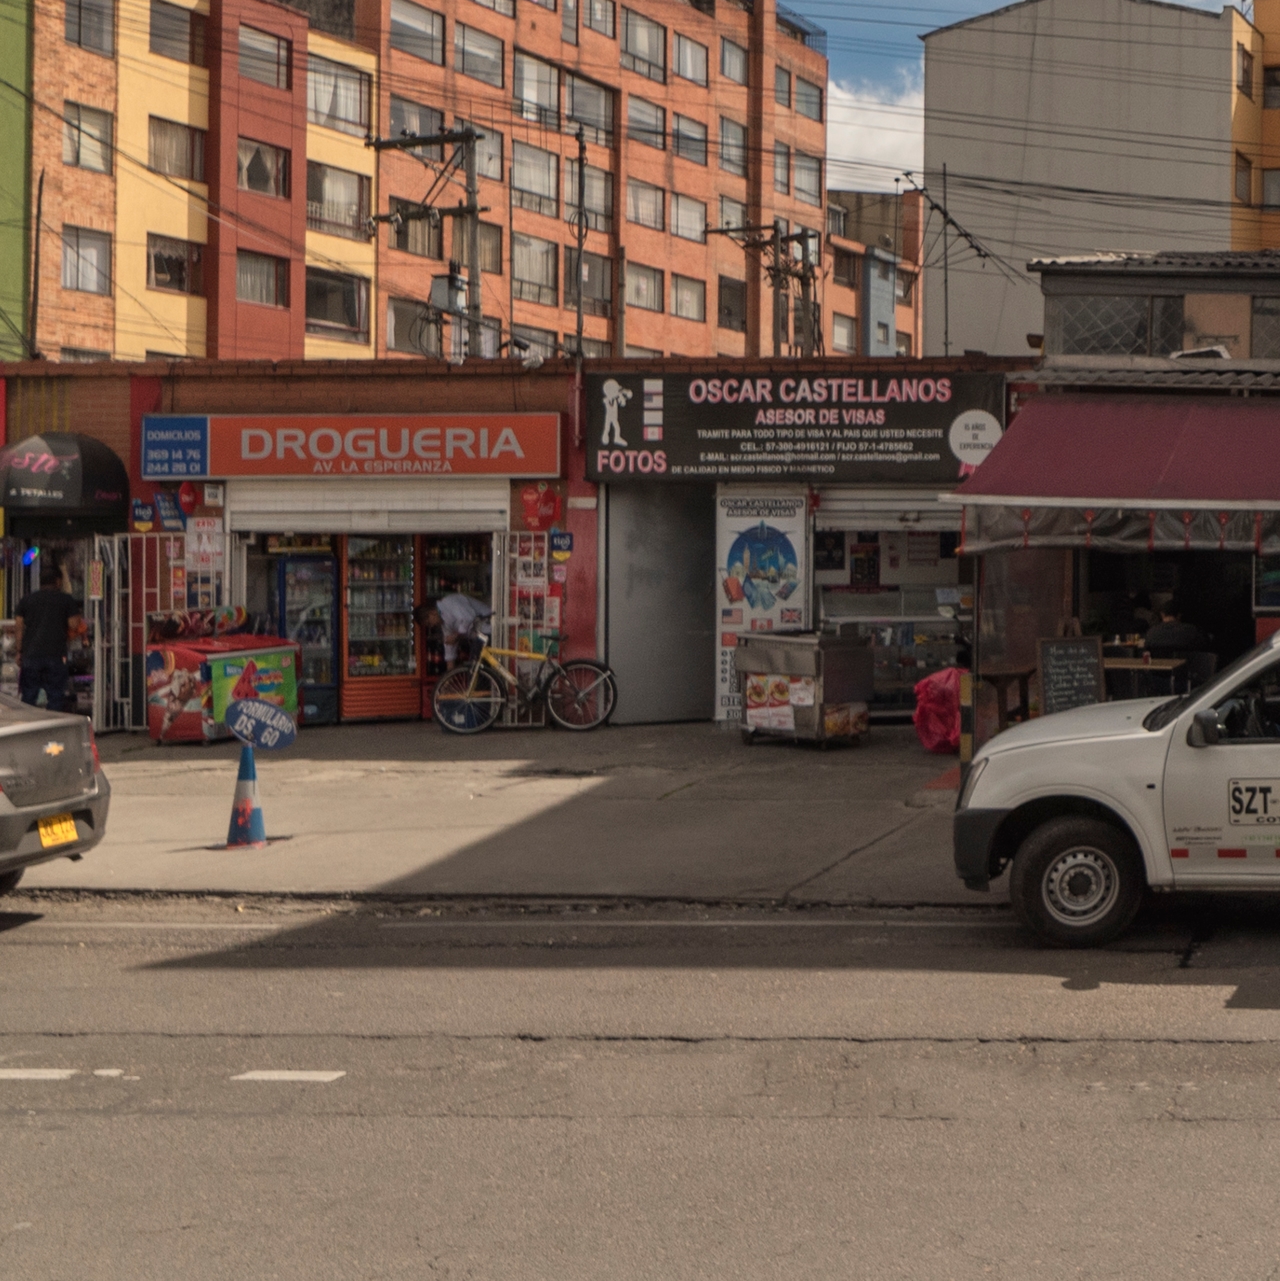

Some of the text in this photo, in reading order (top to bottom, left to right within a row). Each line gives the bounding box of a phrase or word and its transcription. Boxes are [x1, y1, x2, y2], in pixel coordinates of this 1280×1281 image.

[689, 378, 952, 403] OSCAR CASTELLANOS
[755, 408, 886, 425] ASESOR DE VISAS
[147, 430, 201, 440] DOMICILIOS
[697, 429, 943, 439] TRAMITE PARA TODO TIPO DE VISA Y AL PAIS QUE USTED NECESITE
[241, 427, 525, 460] DROGUERIA
[836, 441, 857, 451] FIJO
[313, 461, 453, 473] AV. LA ESPERANZA
[597, 450, 668, 473] FOTOS
[671, 465, 682, 475] DE
[684, 465, 717, 475] CALIDAD
[719, 465, 730, 475] EN
[731, 465, 755, 475] MEDIO
[756, 465, 782, 475] FISICO
[237, 700, 293, 735] FORMULARIO
[260, 727, 280, 747] 60
